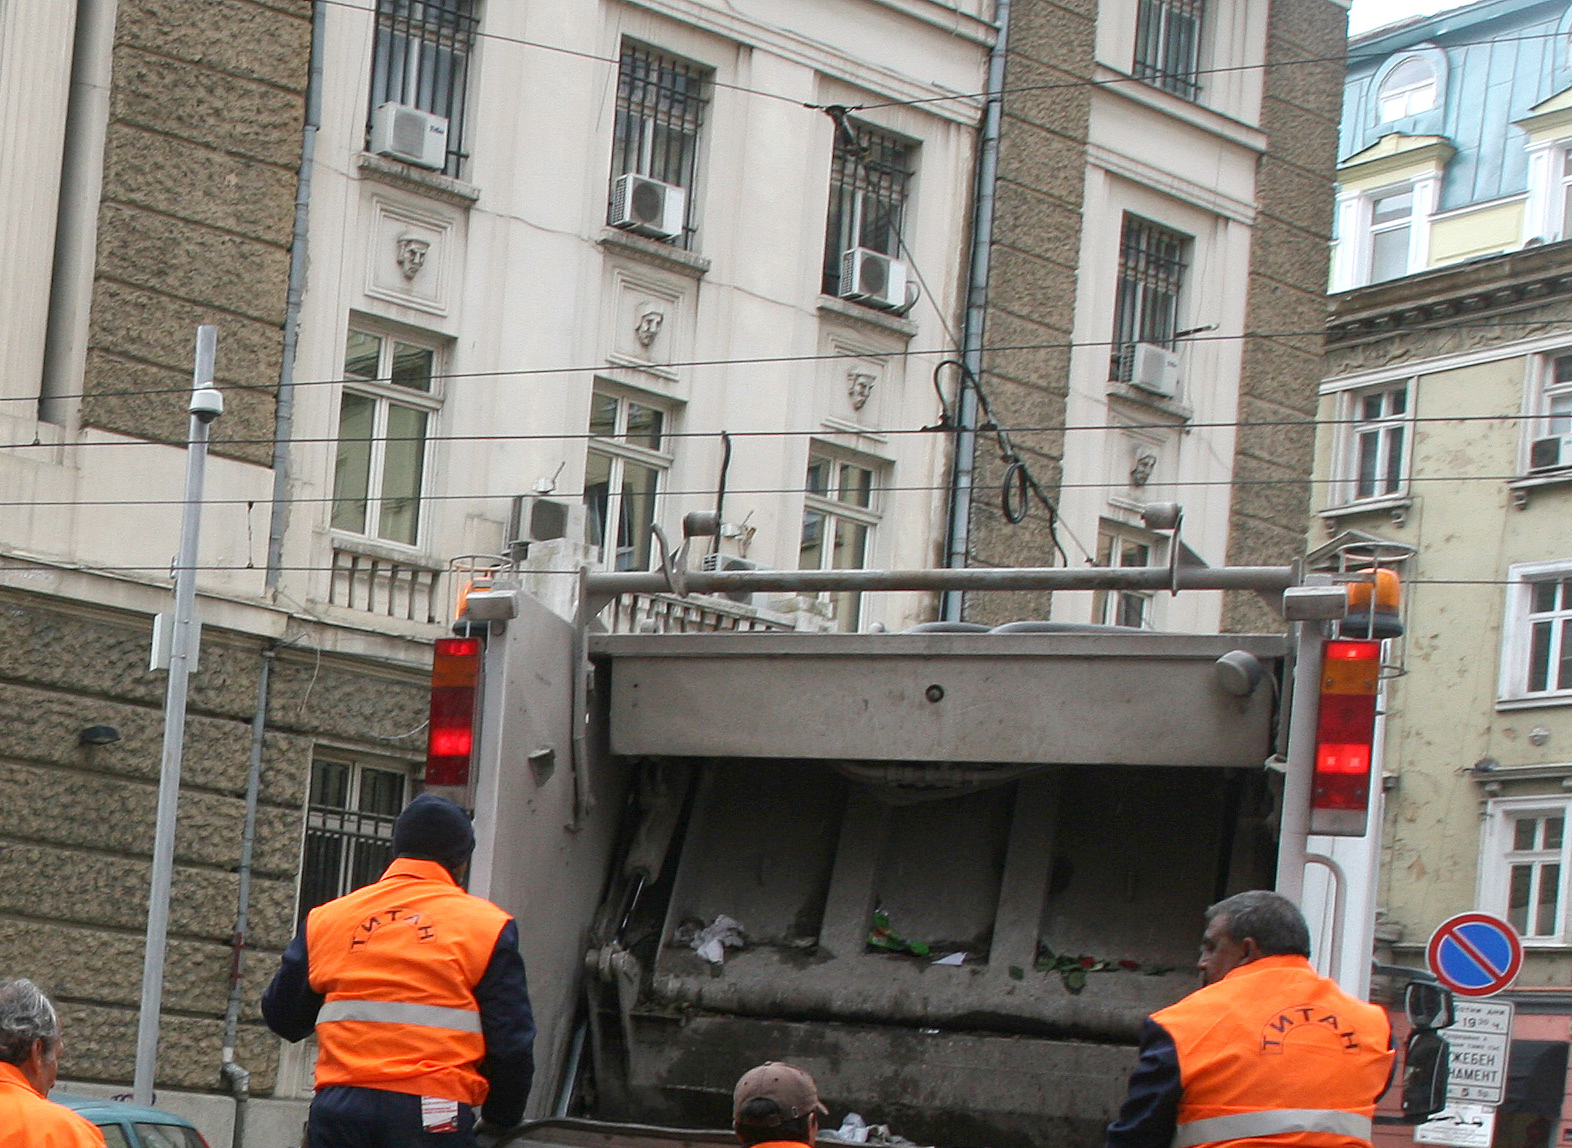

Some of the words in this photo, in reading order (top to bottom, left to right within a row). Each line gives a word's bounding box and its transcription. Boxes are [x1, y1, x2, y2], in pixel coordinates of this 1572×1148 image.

[352, 910, 434, 949] ТИТАН
[1262, 1008, 1359, 1050] ТИТАН
[1450, 1051, 1495, 1066] ЖЕБЕН
[1449, 1067, 1499, 1082] НАМЕНТ
